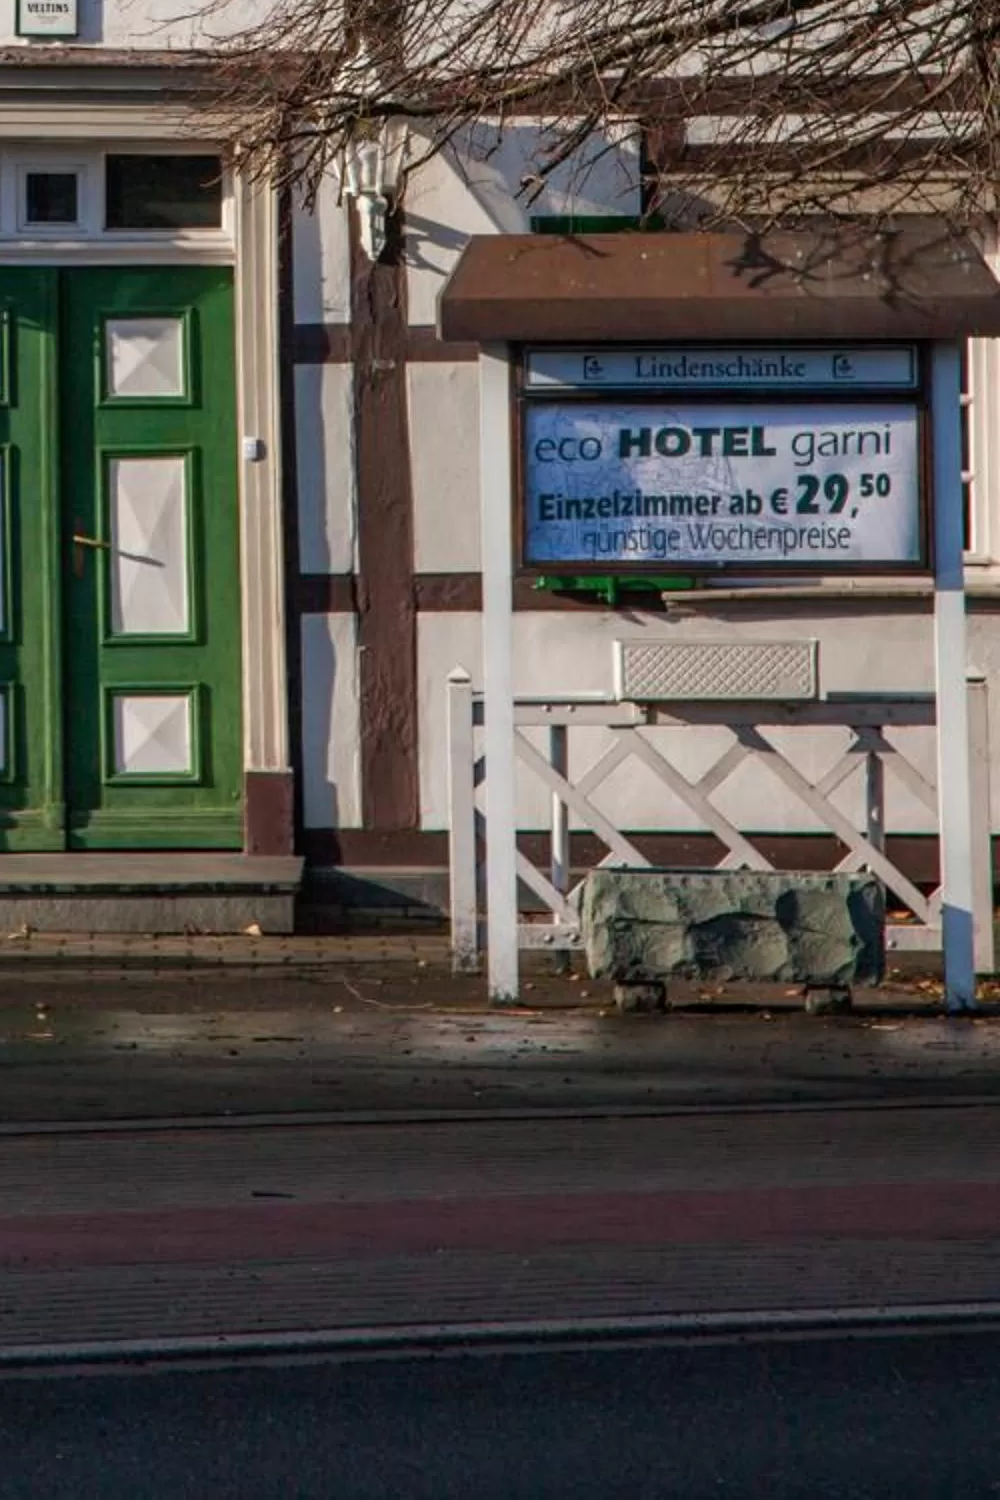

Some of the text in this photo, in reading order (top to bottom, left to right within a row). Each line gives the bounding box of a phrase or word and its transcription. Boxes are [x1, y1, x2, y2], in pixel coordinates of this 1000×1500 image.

[27, 3, 69, 13] VELTINS
[635, 355, 806, 379] Lindenschänke
[535, 424, 891, 467] eco HOTEL garni
[538, 489, 722, 521] Einzelzimmer
[729, 488, 763, 516] ab
[583, 521, 851, 561] günstige Wochenpreise
